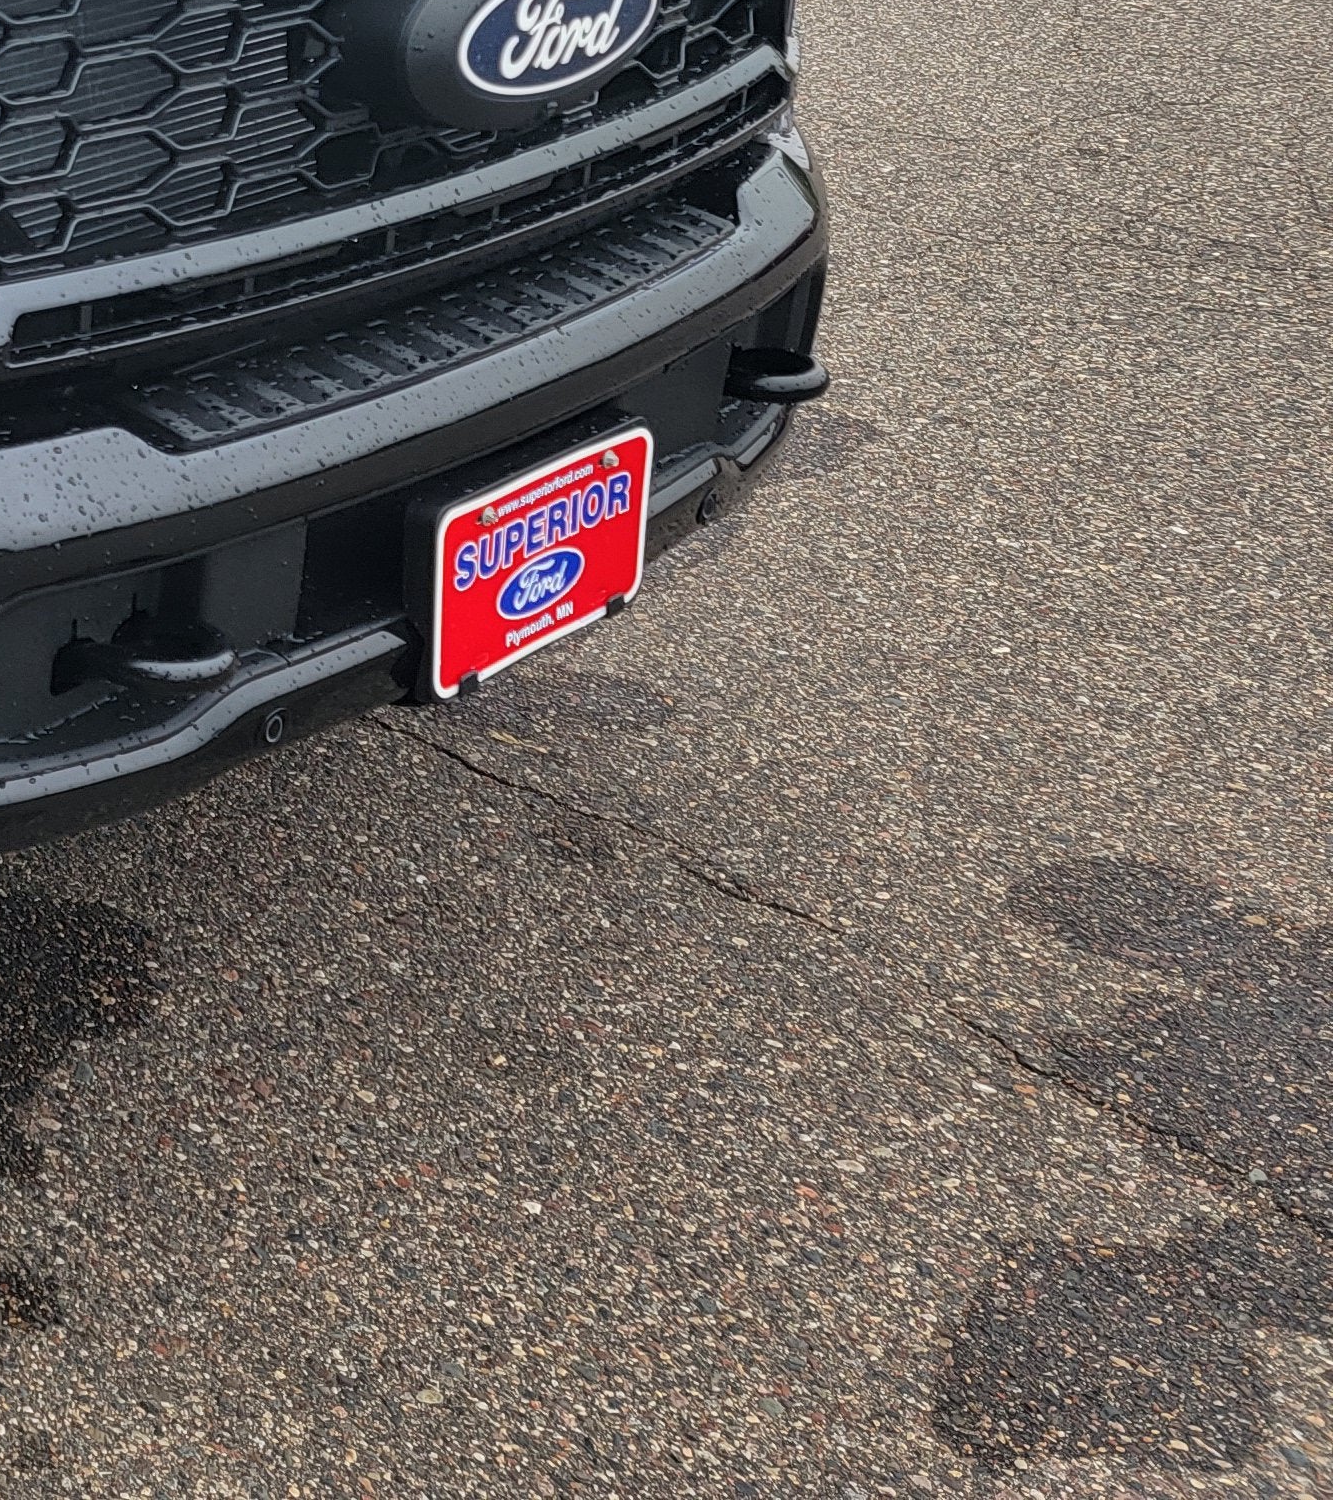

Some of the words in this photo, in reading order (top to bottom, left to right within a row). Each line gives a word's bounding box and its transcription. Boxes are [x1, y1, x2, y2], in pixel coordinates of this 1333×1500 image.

[497, 465, 593, 517] www.superiorford.com
[454, 472, 632, 591] SUPERIOR
[514, 558, 569, 611] Ford
[504, 615, 555, 648] Plymouth,
[556, 601, 574, 622] MN
